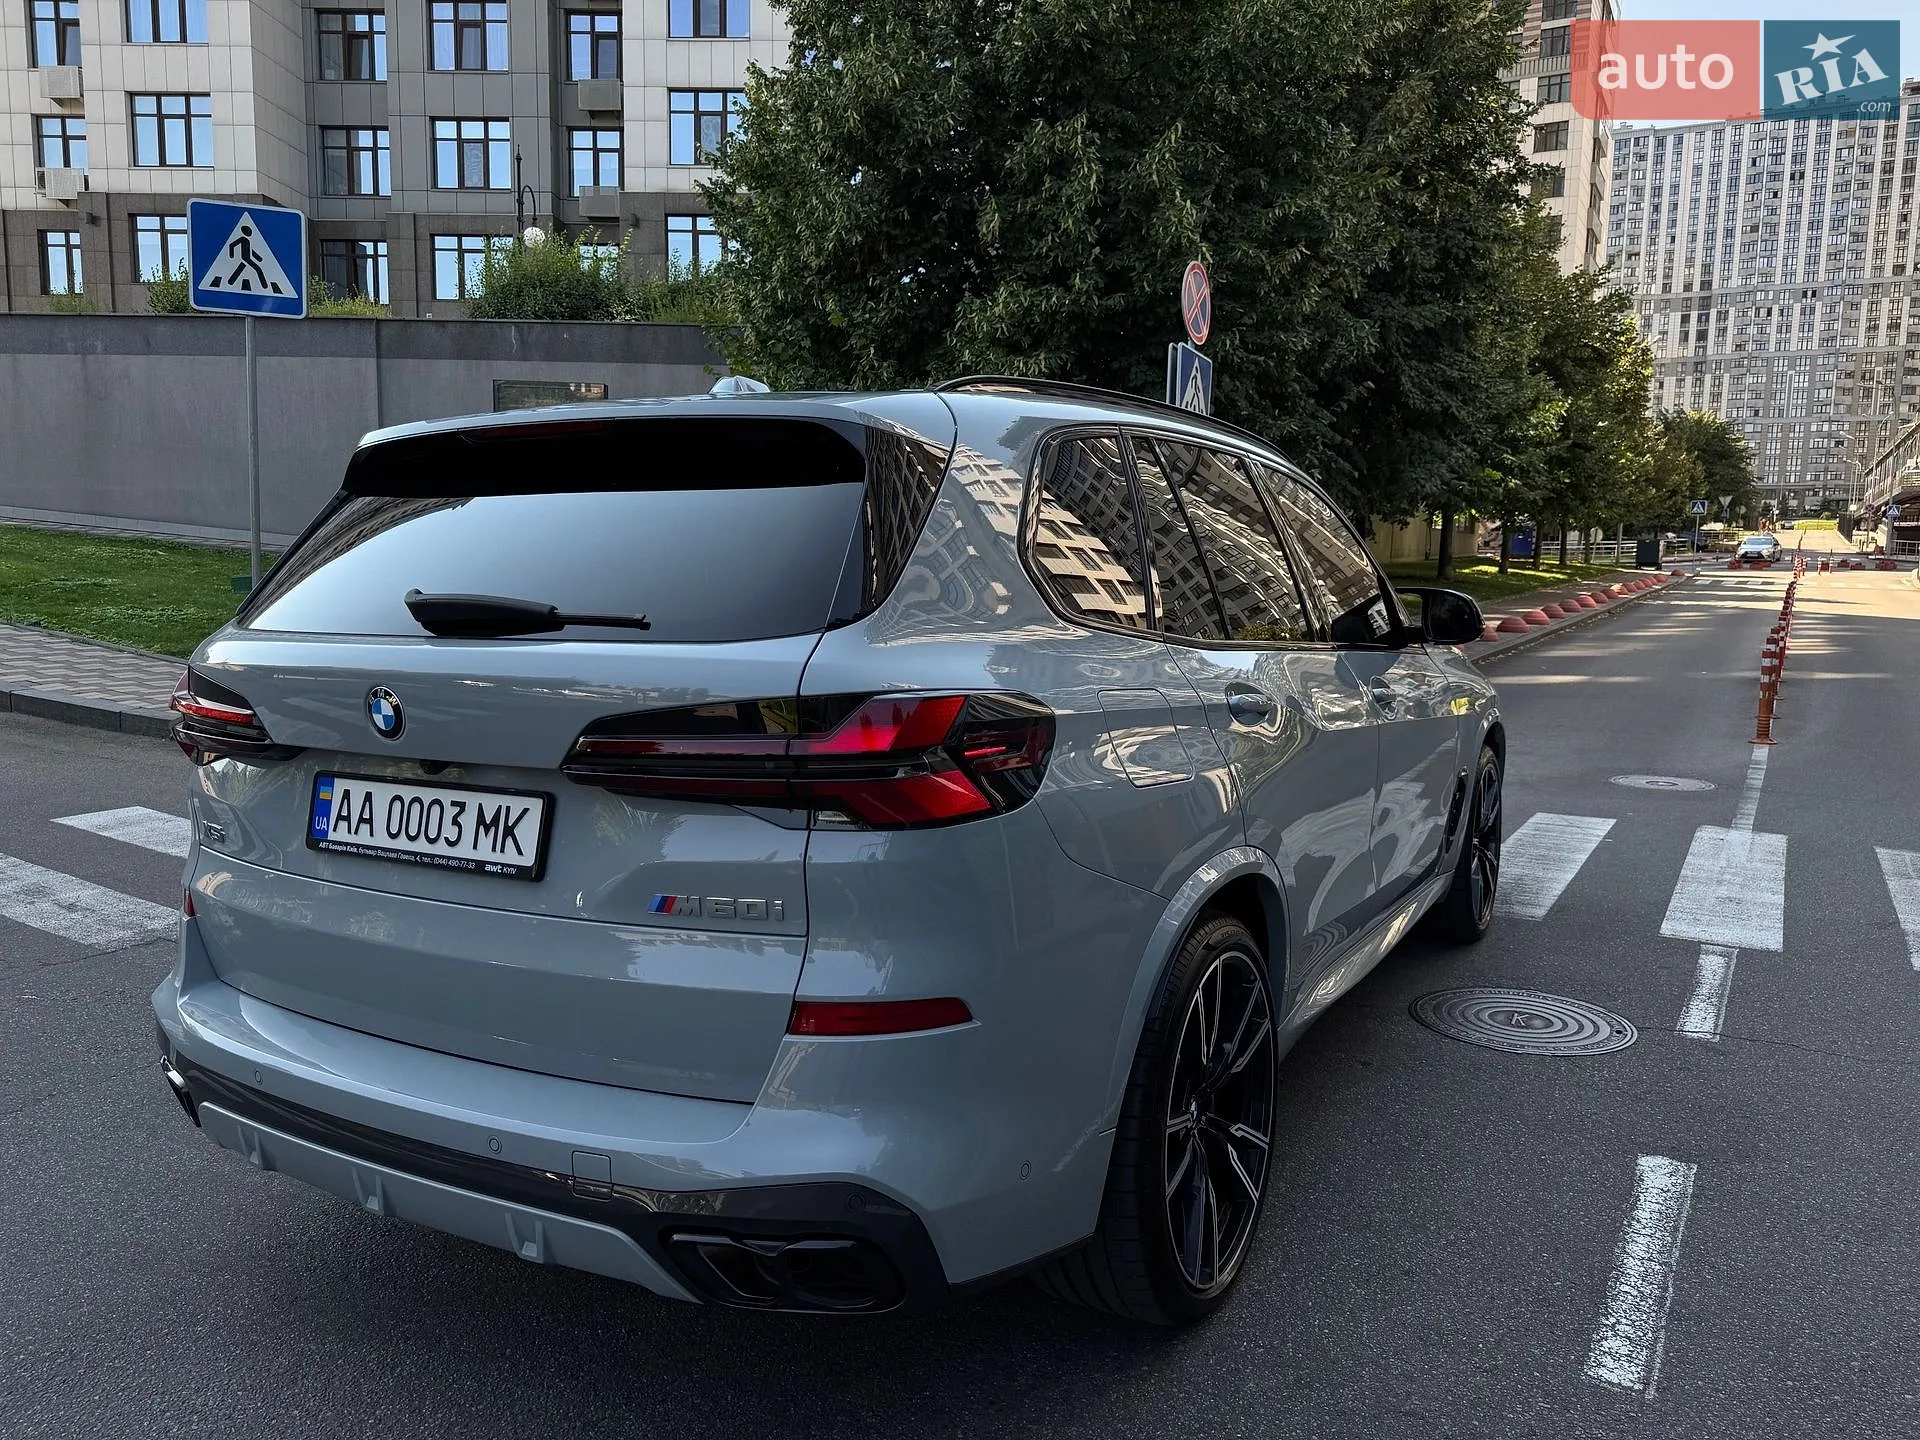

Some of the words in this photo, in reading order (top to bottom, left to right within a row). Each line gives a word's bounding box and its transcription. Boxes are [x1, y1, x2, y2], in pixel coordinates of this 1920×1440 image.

[315, 815, 328, 831] UA
[332, 788, 374, 837] AA
[385, 794, 467, 848] 0003
[472, 802, 530, 856] MK
[433, 857, 448, 866] (044)
[448, 859, 475, 869] 490-77-33
[484, 863, 502, 873] awt
[1510, 1012, 1529, 1026] K
